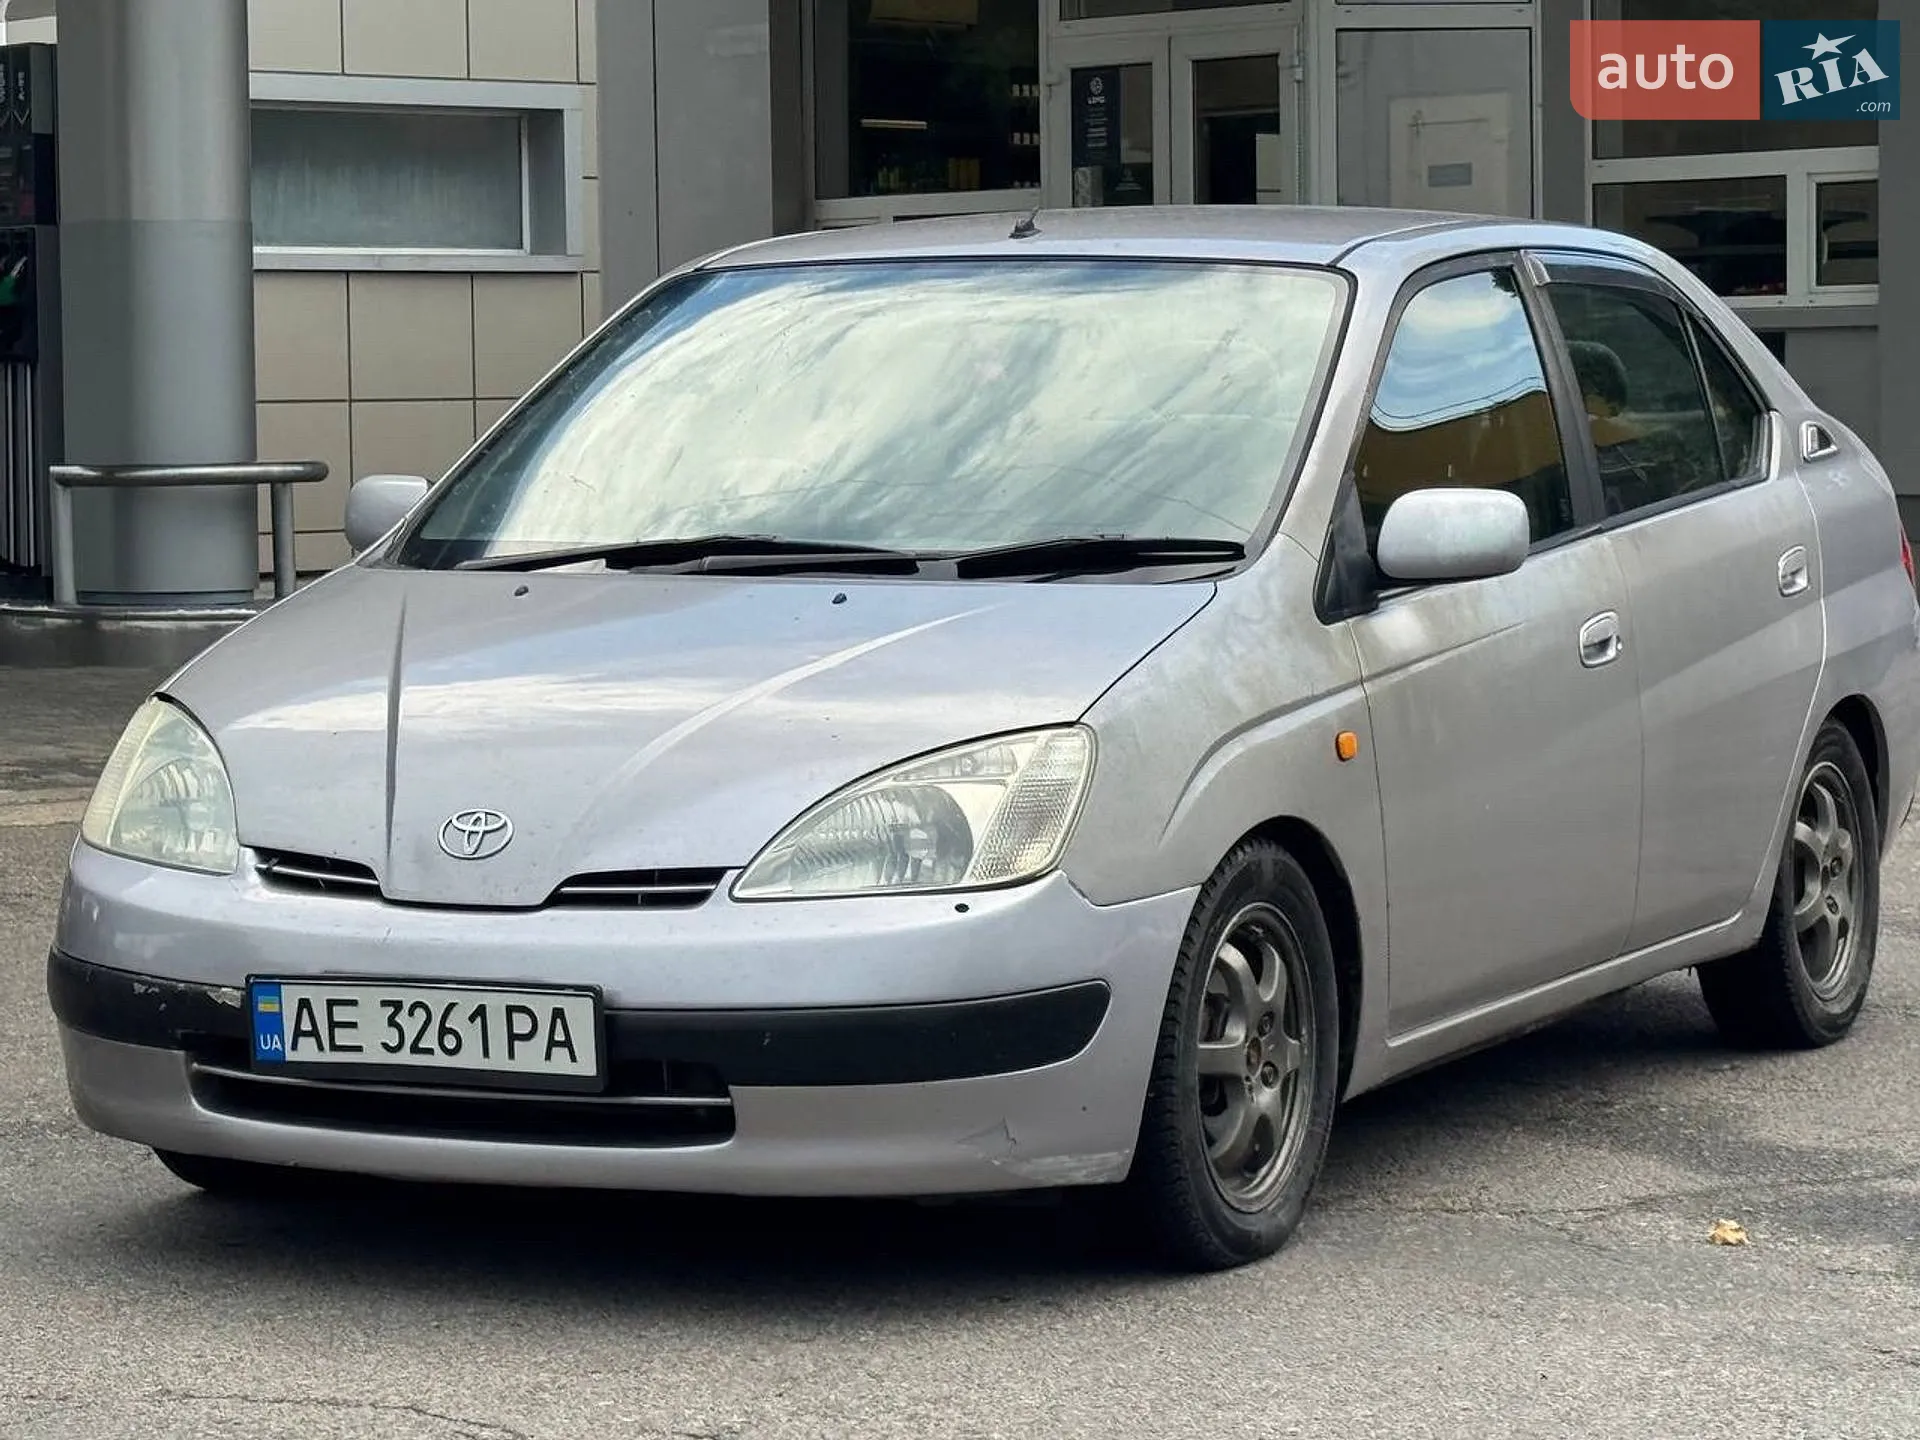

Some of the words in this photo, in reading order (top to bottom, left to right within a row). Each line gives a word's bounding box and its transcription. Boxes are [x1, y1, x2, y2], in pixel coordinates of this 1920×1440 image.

[259, 1033, 283, 1052] UA
[291, 997, 364, 1053] AE
[379, 998, 491, 1060] 3261
[505, 1004, 578, 1064] PA
